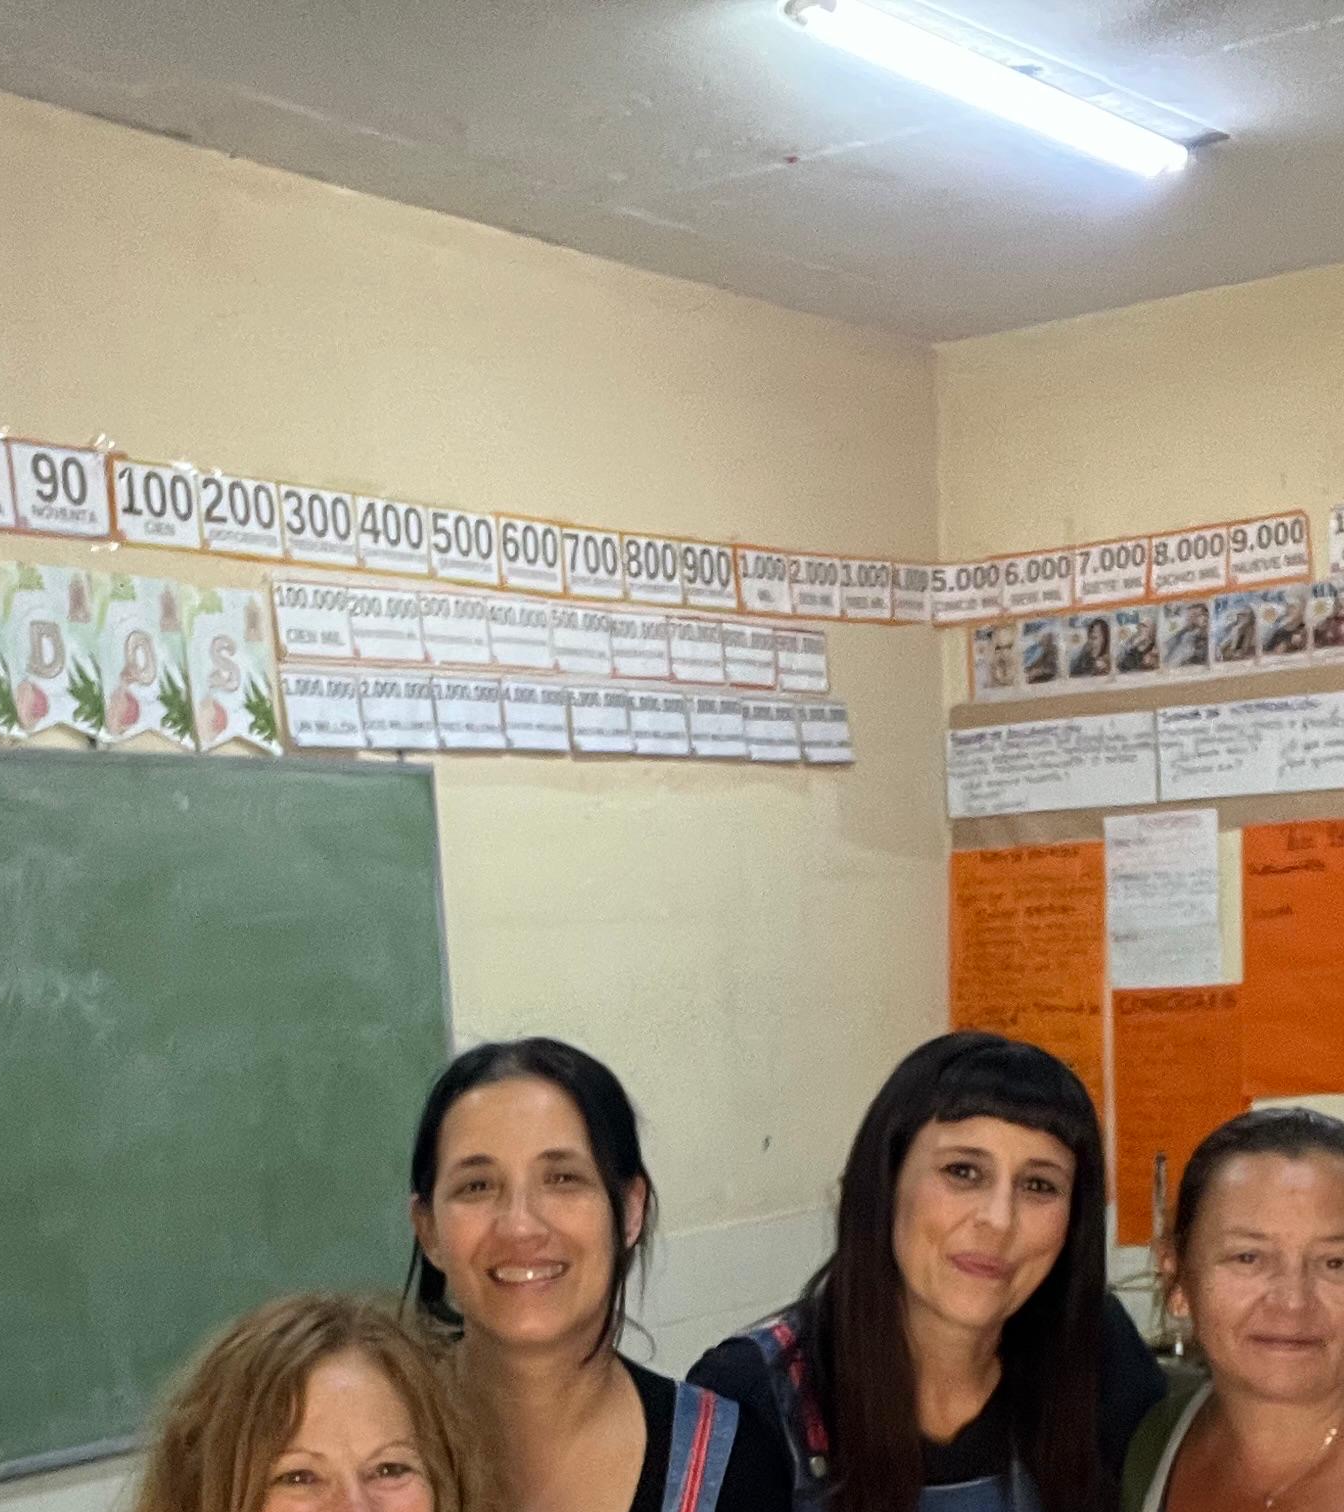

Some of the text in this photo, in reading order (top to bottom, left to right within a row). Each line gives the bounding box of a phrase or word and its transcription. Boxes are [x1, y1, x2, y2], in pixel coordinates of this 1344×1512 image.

[31, 453, 88, 506] 90
[118, 466, 194, 523] 100
[201, 477, 276, 530] 200
[283, 490, 351, 542] 300
[360, 501, 424, 551] 400
[432, 511, 494, 560] 500
[502, 522, 558, 569] 600
[563, 532, 618, 577] 700
[1154, 532, 1224, 567] 8.000
[1231, 517, 1304, 553] 9.000
[624, 538, 676, 582] 800
[682, 545, 731, 588] 900
[931, 564, 1000, 593] 5.000
[1006, 555, 1071, 586] 6.000
[1078, 543, 1146, 577] 7.000
